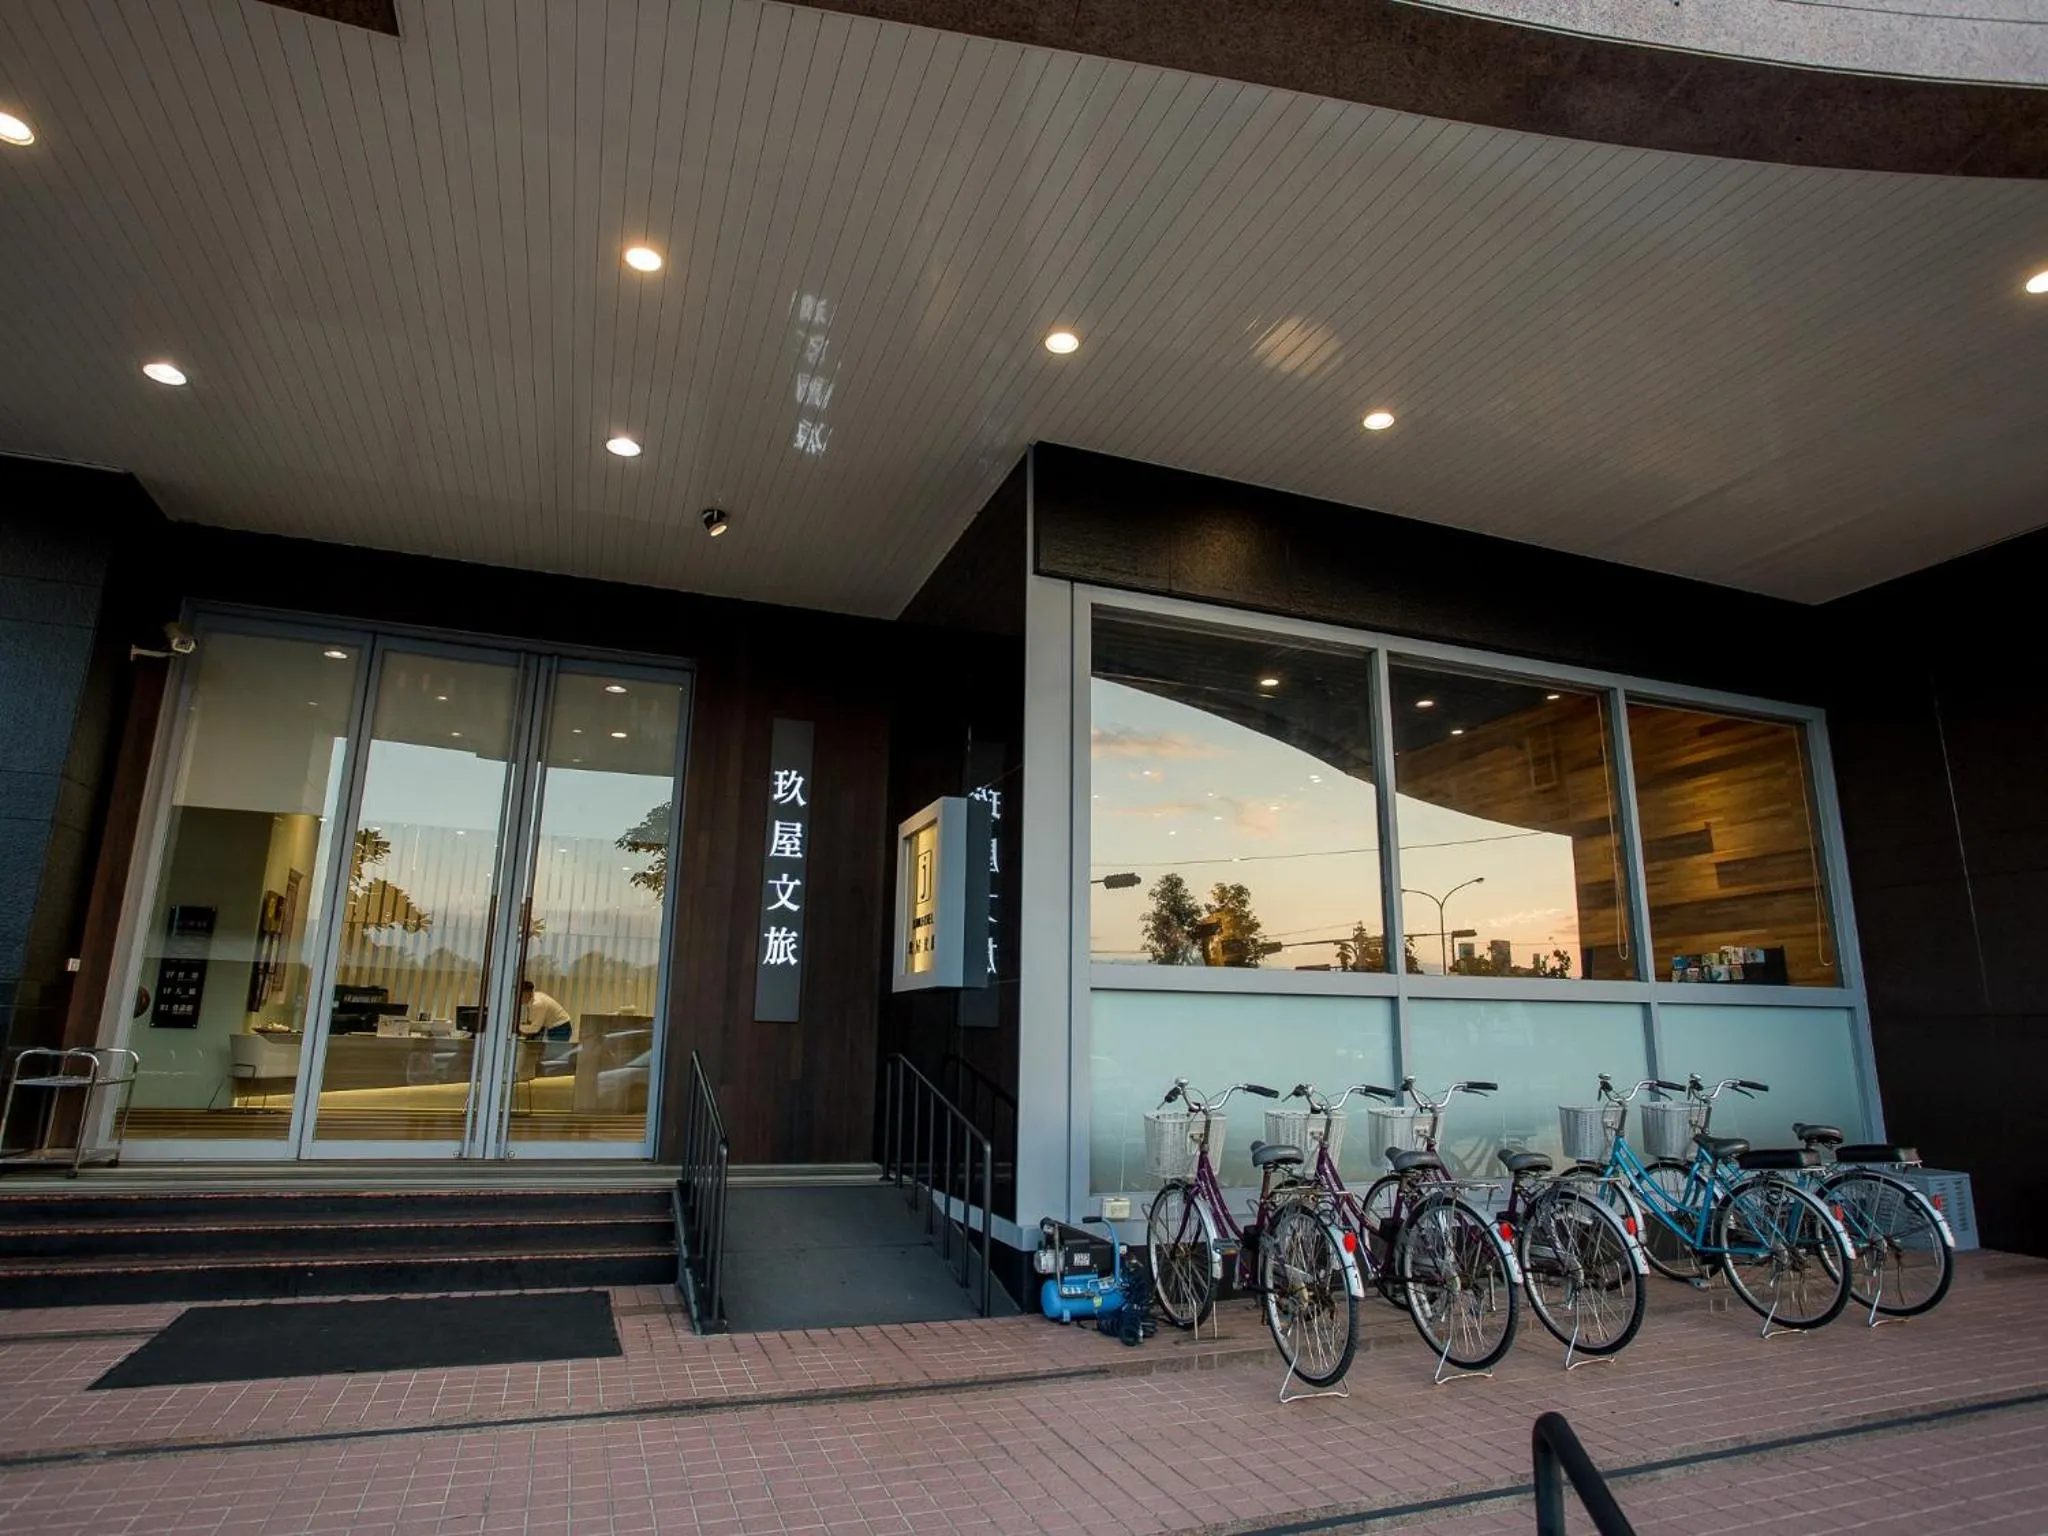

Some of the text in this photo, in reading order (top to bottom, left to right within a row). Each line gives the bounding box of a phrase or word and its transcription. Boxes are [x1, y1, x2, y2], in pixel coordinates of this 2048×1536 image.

[762, 768, 808, 966] 玖屋文旅
[1353, 1273, 1361, 1290] 1
